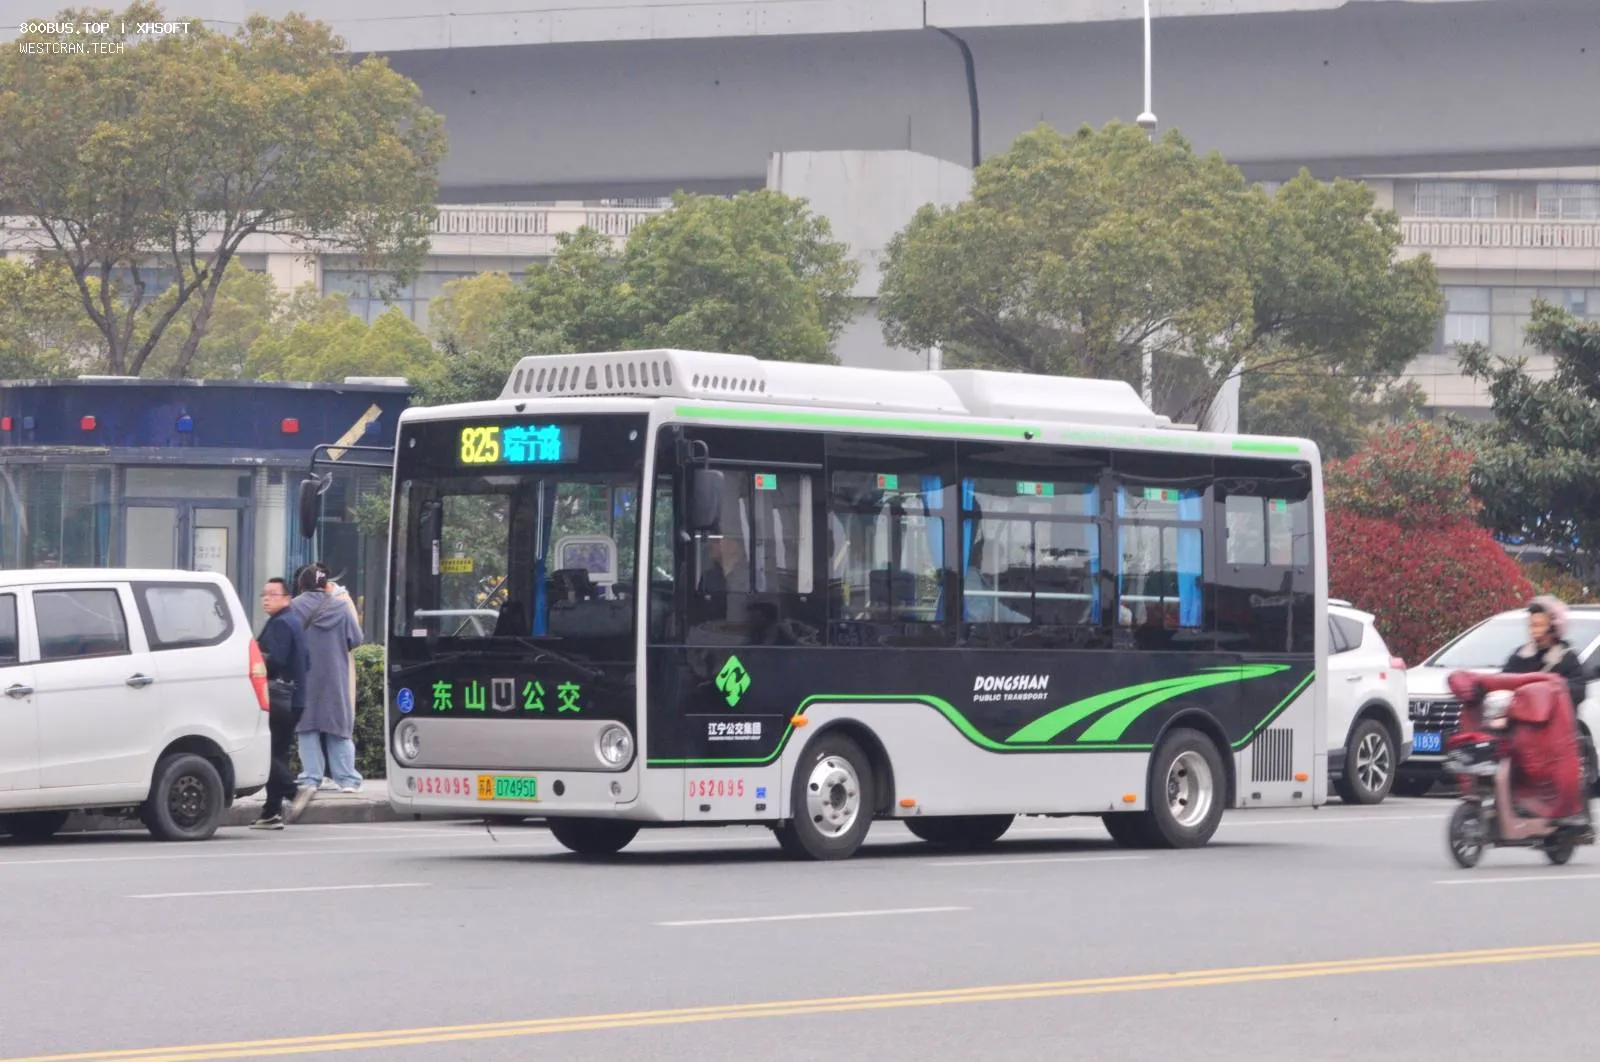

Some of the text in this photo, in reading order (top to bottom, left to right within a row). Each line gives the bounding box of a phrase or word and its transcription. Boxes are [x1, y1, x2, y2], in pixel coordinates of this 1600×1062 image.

[461, 426, 499, 463] 825
[973, 675, 1050, 691] DONGSHAN
[973, 692, 1049, 702] PUBLIC TRANSPORT
[708, 722, 762, 735] 江宁公交集团
[689, 778, 744, 798] DS2095
